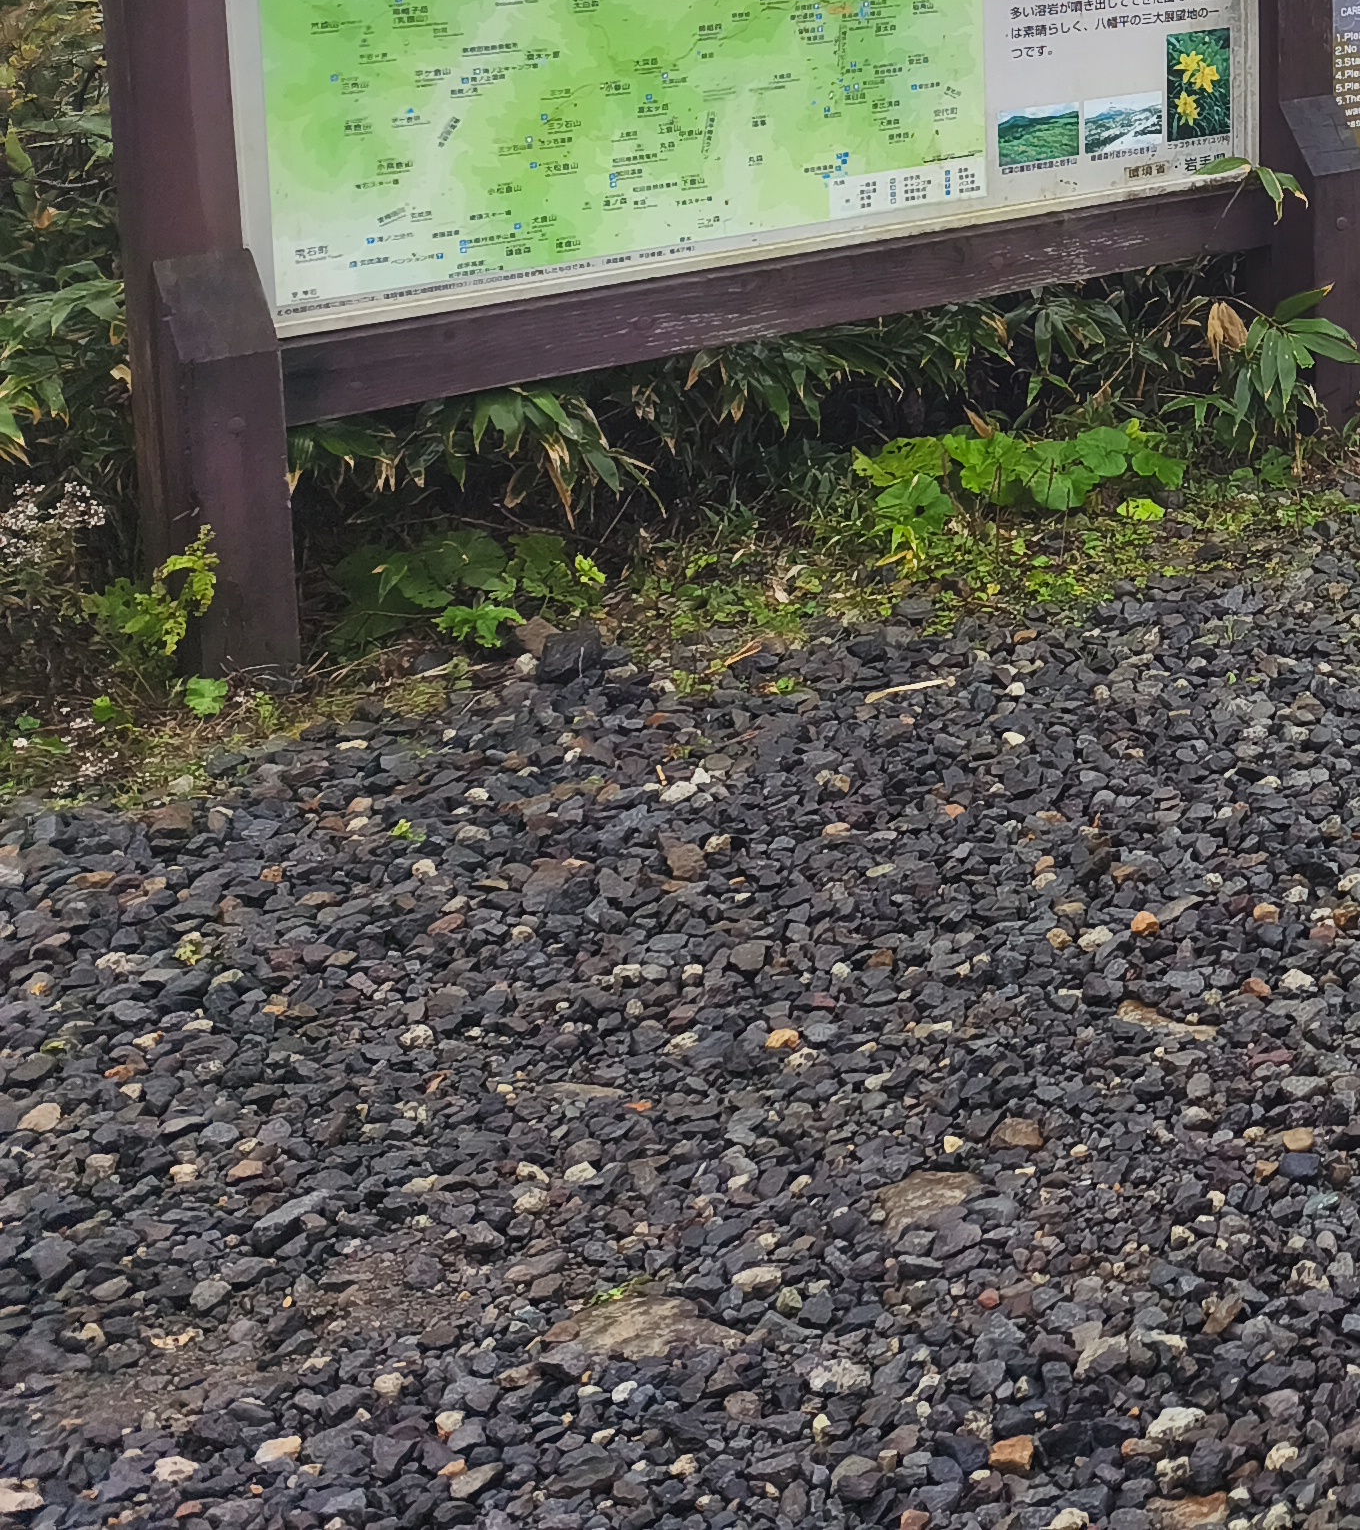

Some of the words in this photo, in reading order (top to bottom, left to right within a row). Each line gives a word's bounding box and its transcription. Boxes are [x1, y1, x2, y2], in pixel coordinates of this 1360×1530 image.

[1011, 7, 1220, 39] は素晴らしく、八幡平の三大展望地の一
[1011, 45, 1053, 59] つです。
[1335, 44, 1358, 56] 2.No
